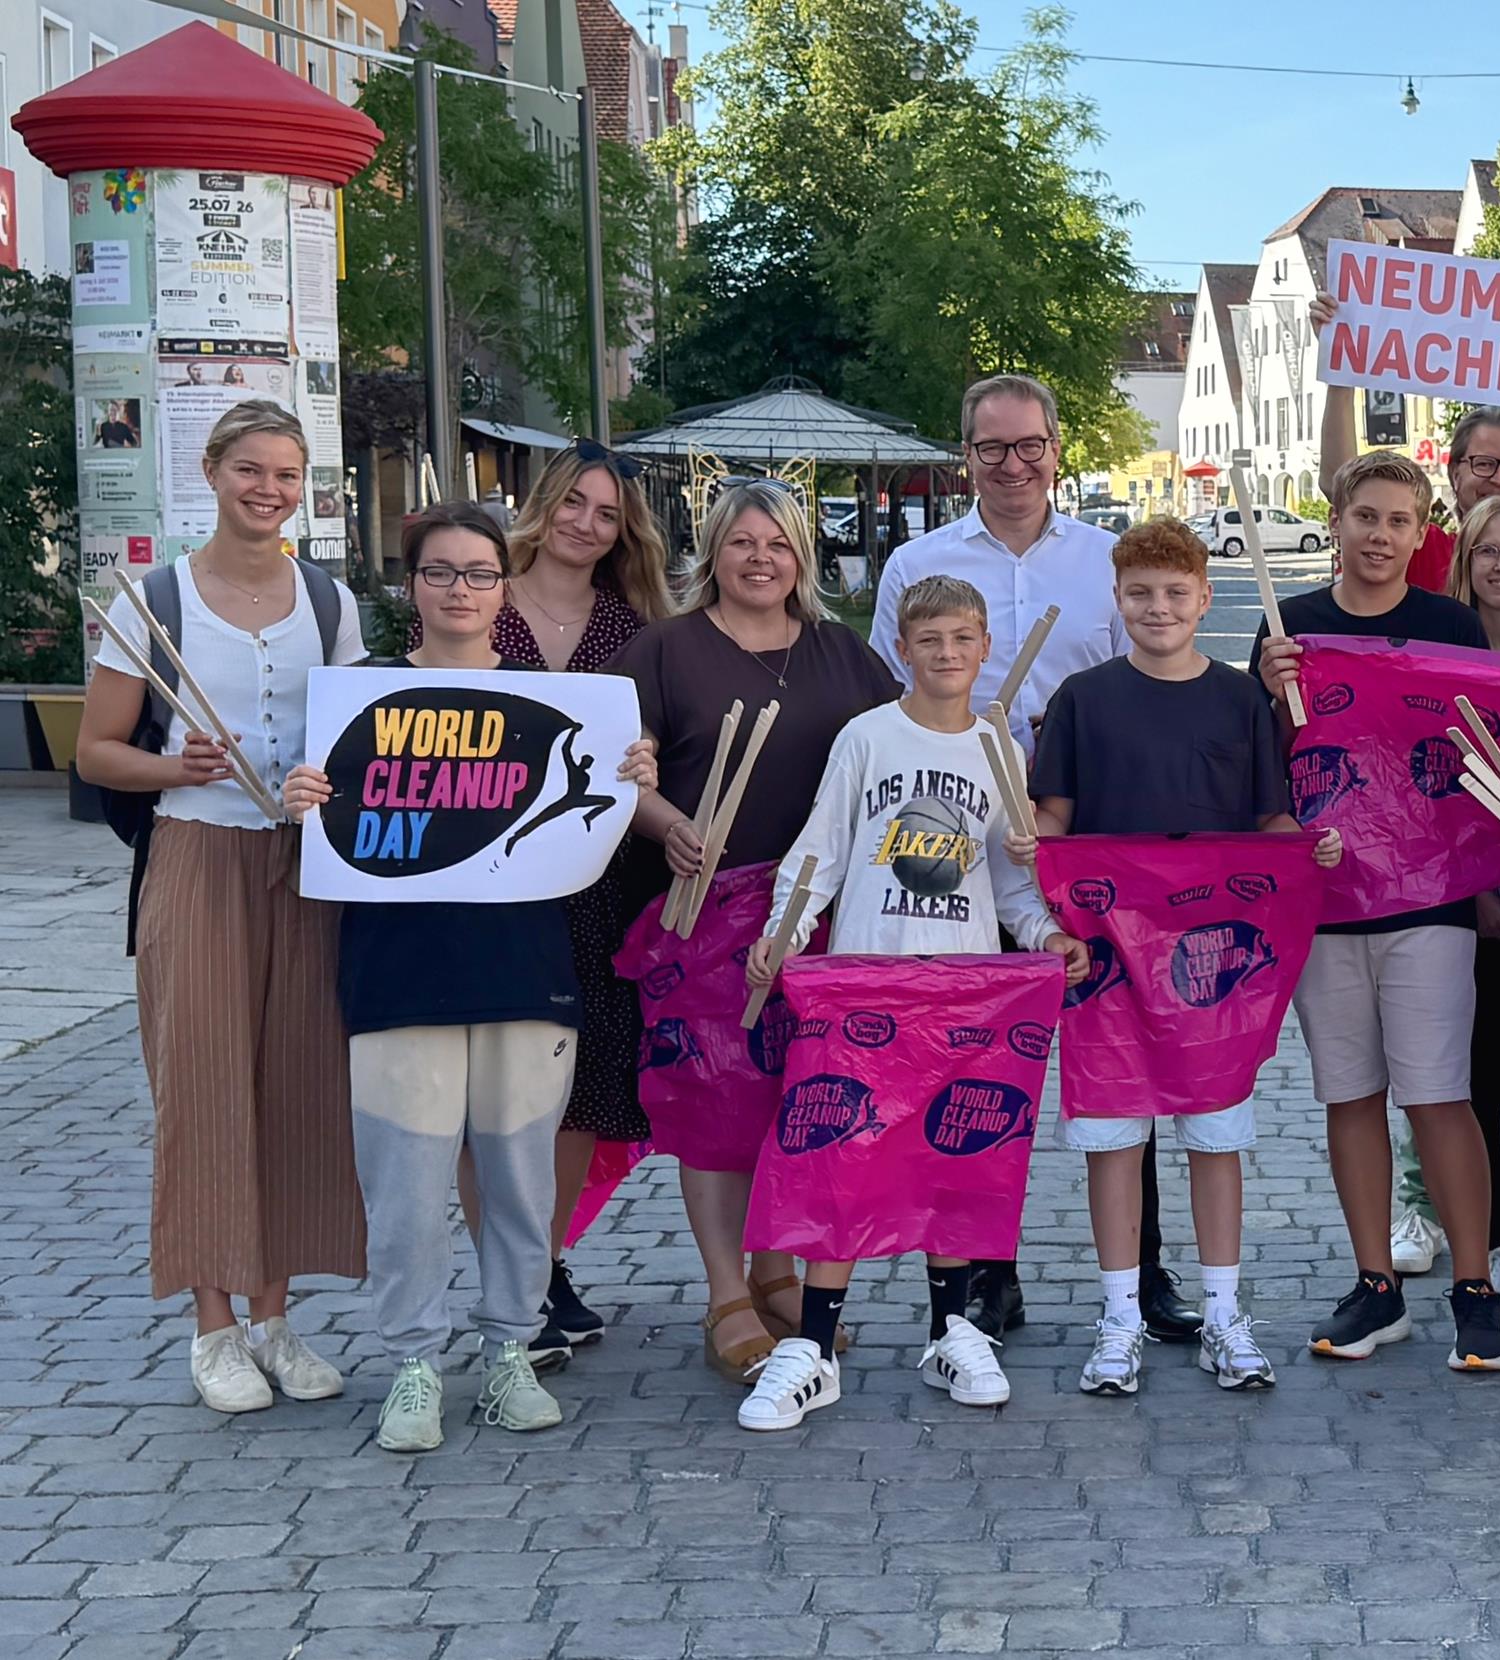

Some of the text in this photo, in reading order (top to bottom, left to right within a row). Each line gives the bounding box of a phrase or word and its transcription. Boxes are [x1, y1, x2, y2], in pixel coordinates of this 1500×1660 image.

[190, 271, 256, 286] EDITION
[374, 707, 506, 758] WORLD
[362, 759, 529, 810] CLEANUP
[866, 773, 904, 821] LOS
[353, 811, 433, 859] DAY
[872, 818, 984, 875] LAKERS
[881, 888, 970, 923] LAKERS
[1172, 885, 1213, 904] swirl
[1184, 927, 1235, 958] WORLD
[1187, 946, 1248, 981] CLEANUP
[796, 1020, 829, 1036] wirl
[855, 1028, 880, 1042] bag
[952, 1029, 994, 1045] swirl
[795, 1082, 844, 1106] WORLD
[950, 1083, 1004, 1111] WORLD
[786, 1103, 852, 1128] CLEANUP
[941, 1105, 1011, 1134] CLEANUP
[781, 1125, 811, 1147] DAY
[933, 1125, 968, 1149] DAY
